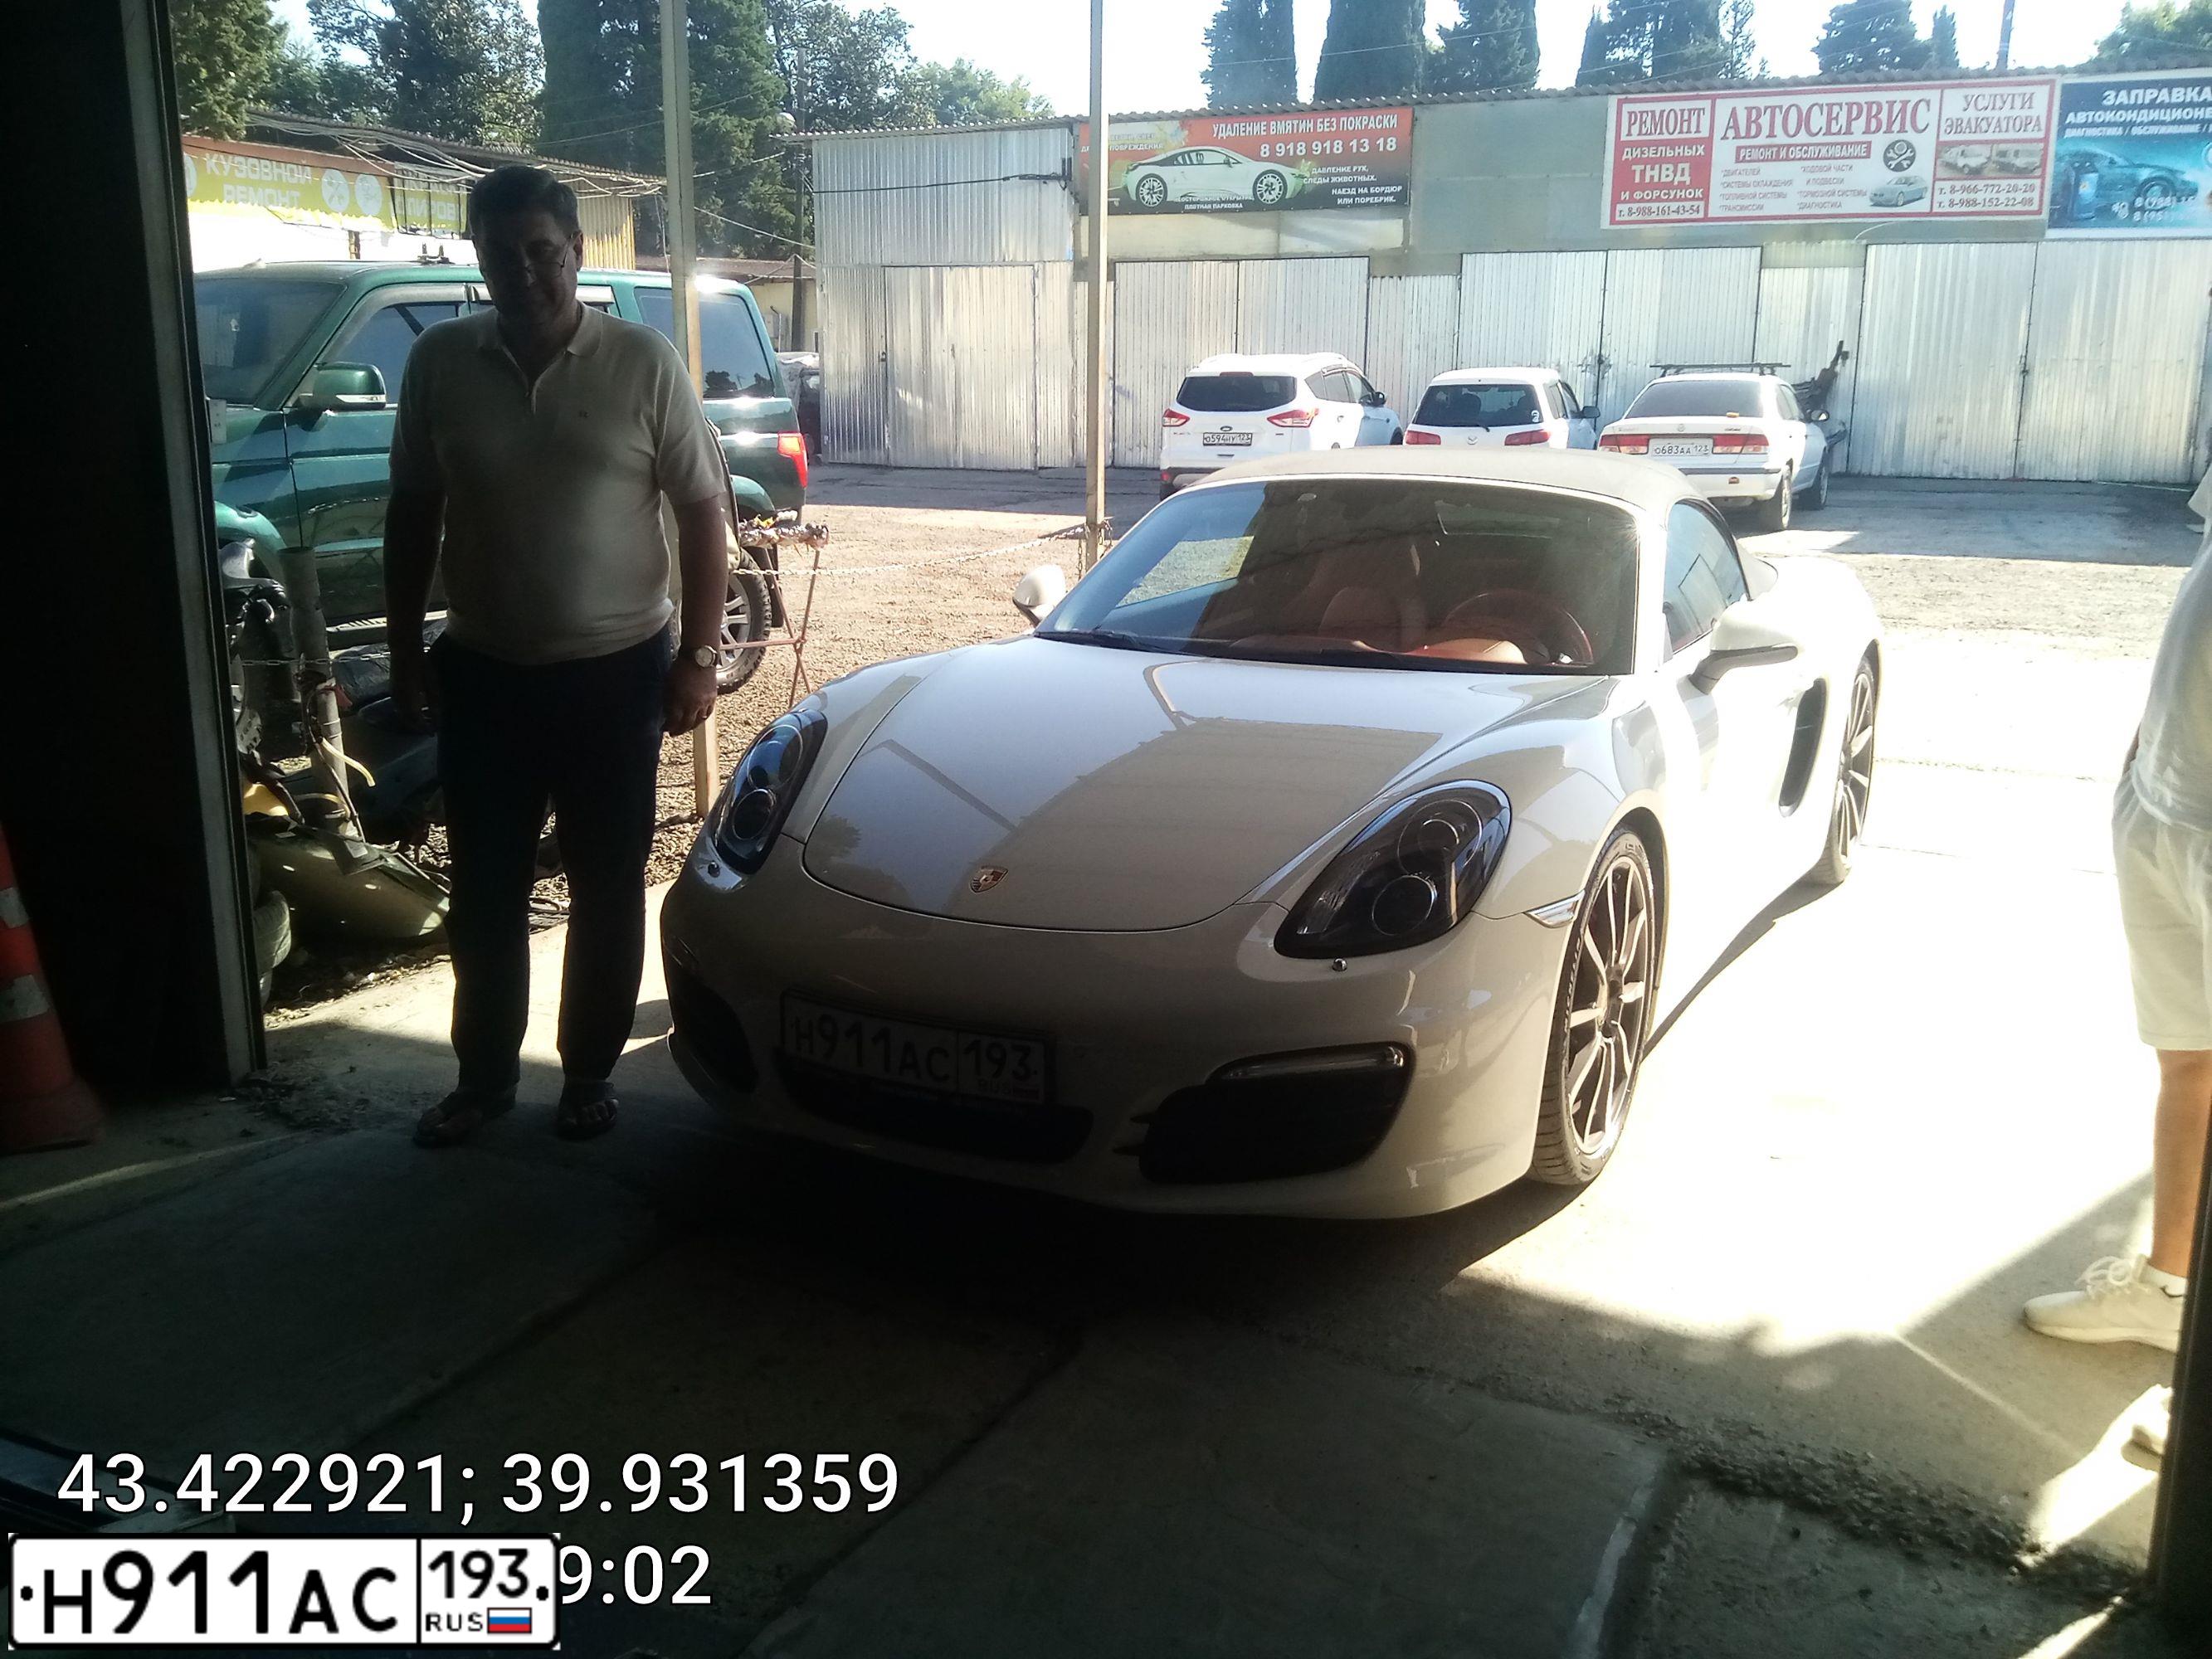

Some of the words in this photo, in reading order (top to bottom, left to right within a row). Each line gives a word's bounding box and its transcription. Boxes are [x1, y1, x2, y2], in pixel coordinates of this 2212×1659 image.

[1962, 92, 2035, 111] УСЛУГИ
[2102, 86, 2212, 105] ЗАПРАВКА
[1212, 121, 1266, 139] УДАЛЕНИЕ
[1270, 119, 1313, 134] ВМЯТИН
[1317, 119, 1337, 132] БЕЗ
[1340, 114, 1397, 130] ПОКРАСКИ
[1626, 107, 1705, 137] РЕМОНТ
[1720, 99, 1931, 140] АВТОСЕРВИС
[1944, 115, 2043, 134] ЭВАКУАТОРА
[1260, 144, 1270, 158] 8
[1275, 142, 1306, 156] 918
[1312, 139, 1343, 154] 918
[1350, 139, 1370, 153] 13
[1376, 137, 1397, 151] 18
[1622, 144, 1705, 161] ДИЗЕЛЬНЫХ
[1740, 148, 1777, 160] РЕМОНТ
[1779, 148, 1786, 159] И
[1789, 144, 1868, 158] ОБСЛУЖИВАНИЕ
[204, 153, 313, 184] КУЗОВНОЙ
[1312, 166, 1352, 174] ДАВЛЕНИЕ
[1631, 163, 1690, 185] ТНВД
[222, 183, 300, 207] РЕМОНТ
[1620, 191, 1630, 200] И
[1633, 188, 1703, 199] ФОРСУНОК
[1628, 205, 1700, 216] 8-988-161-43-54
[795, 1013, 950, 1082] Н911АС
[962, 1039, 1031, 1082] 193
